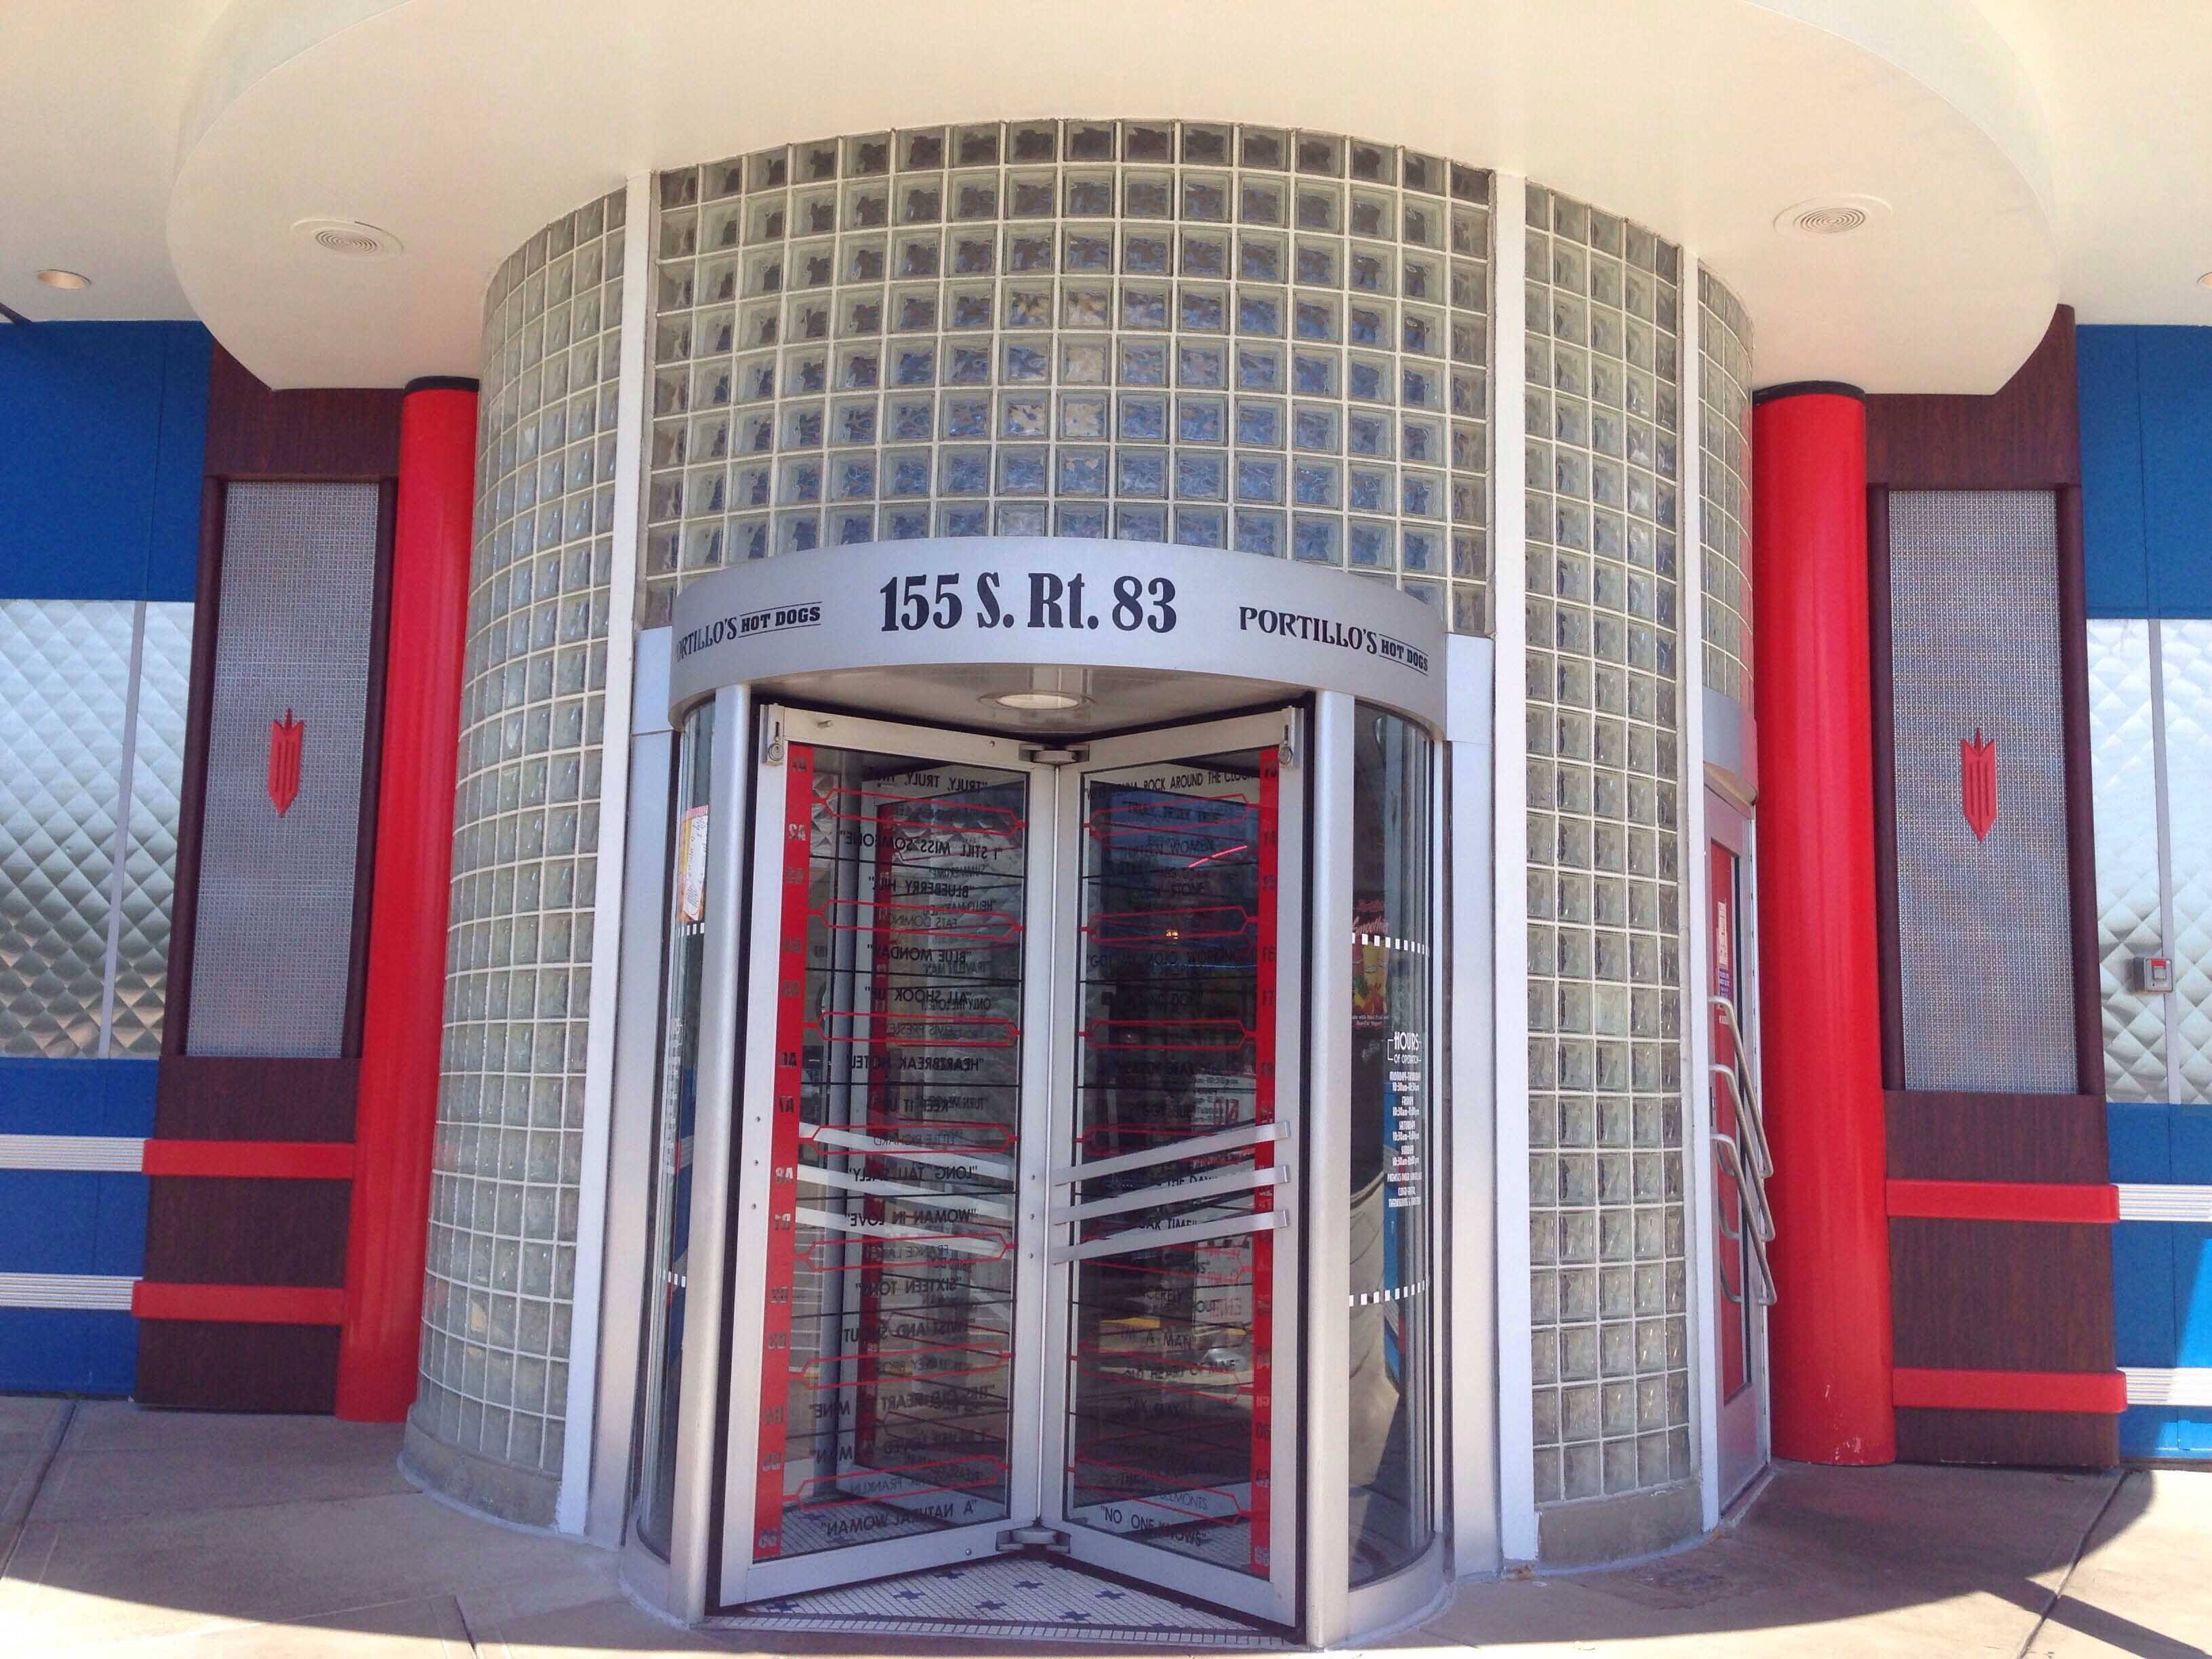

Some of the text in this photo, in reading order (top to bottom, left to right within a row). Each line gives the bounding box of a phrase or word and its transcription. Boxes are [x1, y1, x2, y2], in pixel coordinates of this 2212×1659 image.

[880, 571, 1177, 633] 155 S. Rt. 83
[677, 607, 820, 662] ORTILLO'S HOT DOGS
[1239, 606, 1429, 672] PORTILLO'S HOT DOGS
[1170, 773, 1204, 789] AROUND
[1208, 771, 1224, 784] THE
[1393, 1031, 1419, 1050] HOURS
[1393, 1054, 1401, 1064] OF
[1101, 1506, 1122, 1524] "NO
